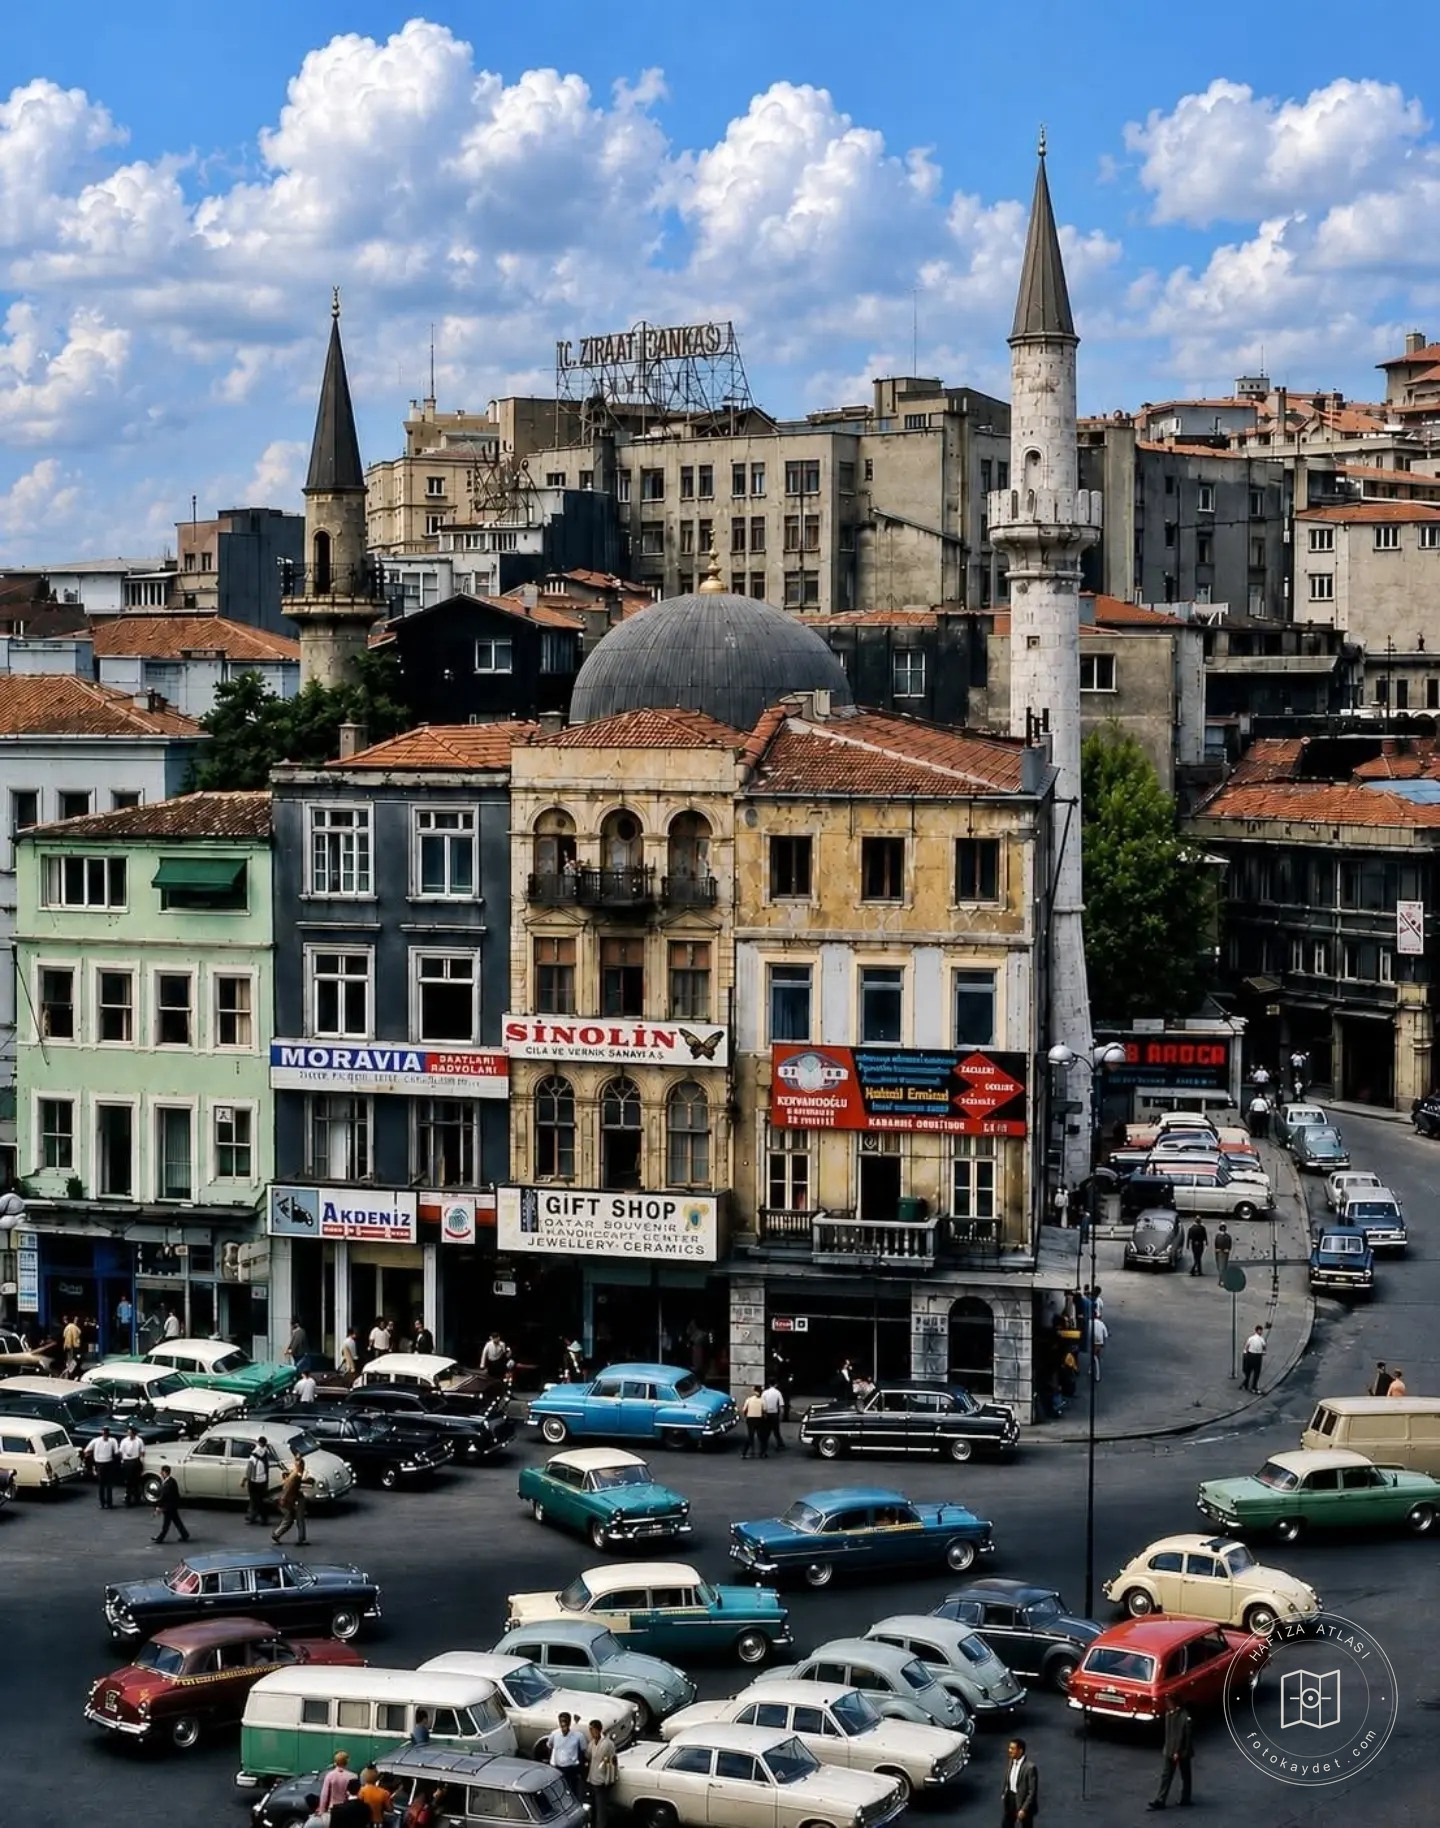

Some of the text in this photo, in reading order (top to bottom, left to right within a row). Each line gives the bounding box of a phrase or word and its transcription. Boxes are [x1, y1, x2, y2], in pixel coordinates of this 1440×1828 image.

[506, 1020, 677, 1049] SİNOLİN
[281, 1047, 421, 1072] MORAVIA
[612, 1199, 676, 1220] SHOP
[623, 1241, 705, 1255] CERAMICS
